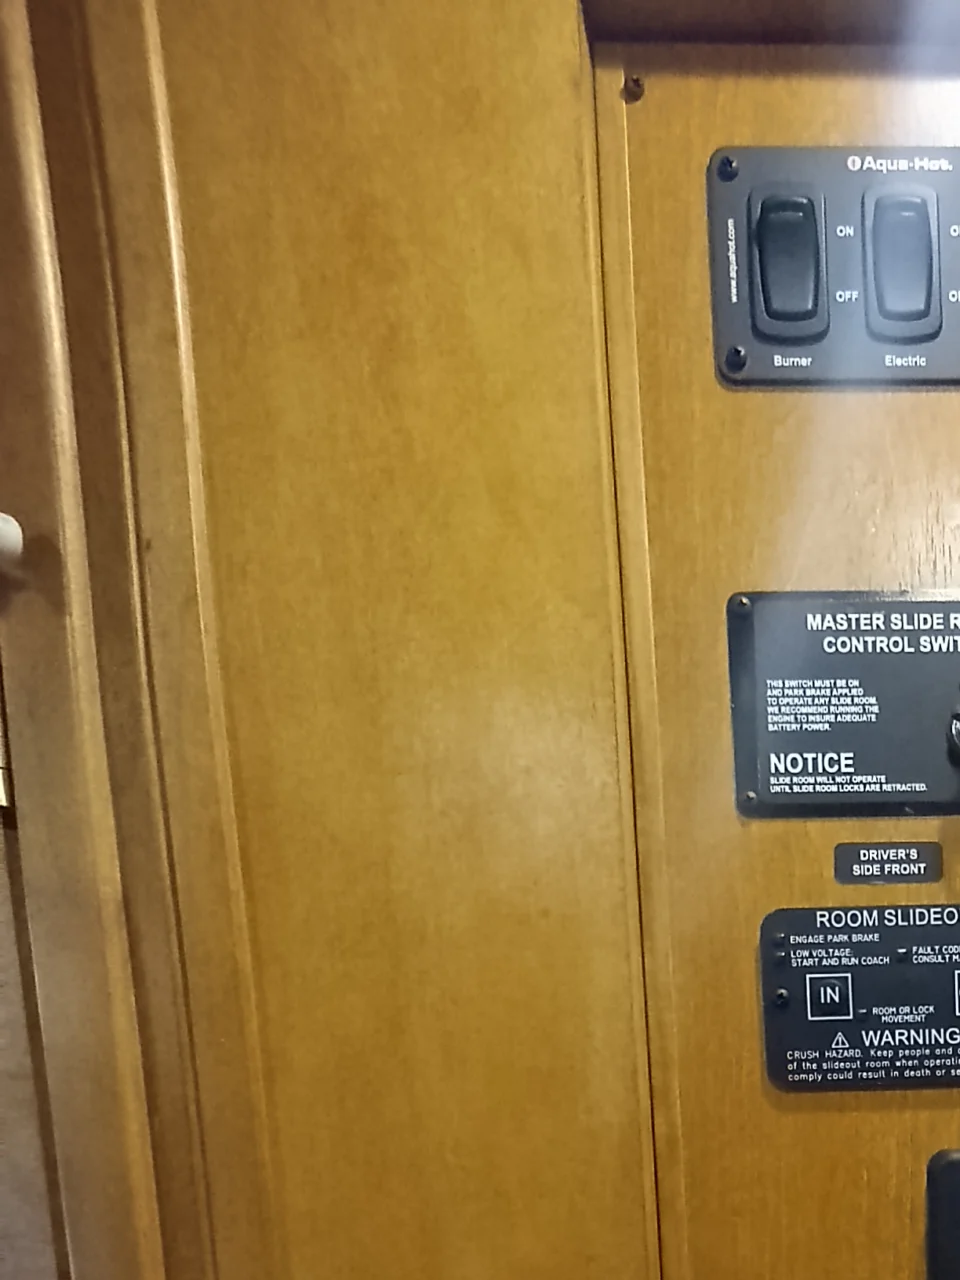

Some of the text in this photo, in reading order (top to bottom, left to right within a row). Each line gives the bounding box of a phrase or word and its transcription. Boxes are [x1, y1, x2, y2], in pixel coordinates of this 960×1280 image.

[836, 225, 854, 237] ON
[836, 290, 859, 302] OFF
[773, 355, 812, 367] Burner
[885, 355, 927, 367] Electric
[806, 614, 886, 631] MASTER
[889, 614, 945, 630] SLIDE
[822, 637, 915, 653] CONTROL
[767, 688, 782, 697] AND
[784, 688, 804, 696] PARK
[796, 714, 807, 723] TO
[837, 713, 876, 722] ADEQUATE
[768, 723, 800, 731] BATTERY
[770, 752, 855, 773] NOTICE
[860, 849, 917, 860] DRIVER'S
[852, 863, 926, 876] SIDE FRONT
[816, 909, 879, 928] ROOM
[790, 933, 880, 944] ENGAGE PARK BRAKE
[790, 950, 809, 958] LOW
[912, 946, 939, 954] FAULT
[791, 956, 890, 967] START AND RUN COACH
[912, 954, 949, 963] CONSULT
[820, 987, 840, 1003] IN
[872, 1005, 935, 1015] ROOM OR LOCK
[881, 1015, 926, 1023] MOVEMENT
[861, 1028, 960, 1047] WARNING
[787, 1050, 819, 1060] CRUSH
[870, 1048, 894, 1058] Keep
[899, 1048, 930, 1057] people
[935, 1047, 953, 1055] and
[788, 1071, 822, 1082] comply
[827, 1070, 853, 1079] could
[858, 1069, 886, 1079] result
[890, 1069, 899, 1077] in
[904, 1068, 931, 1077] death
